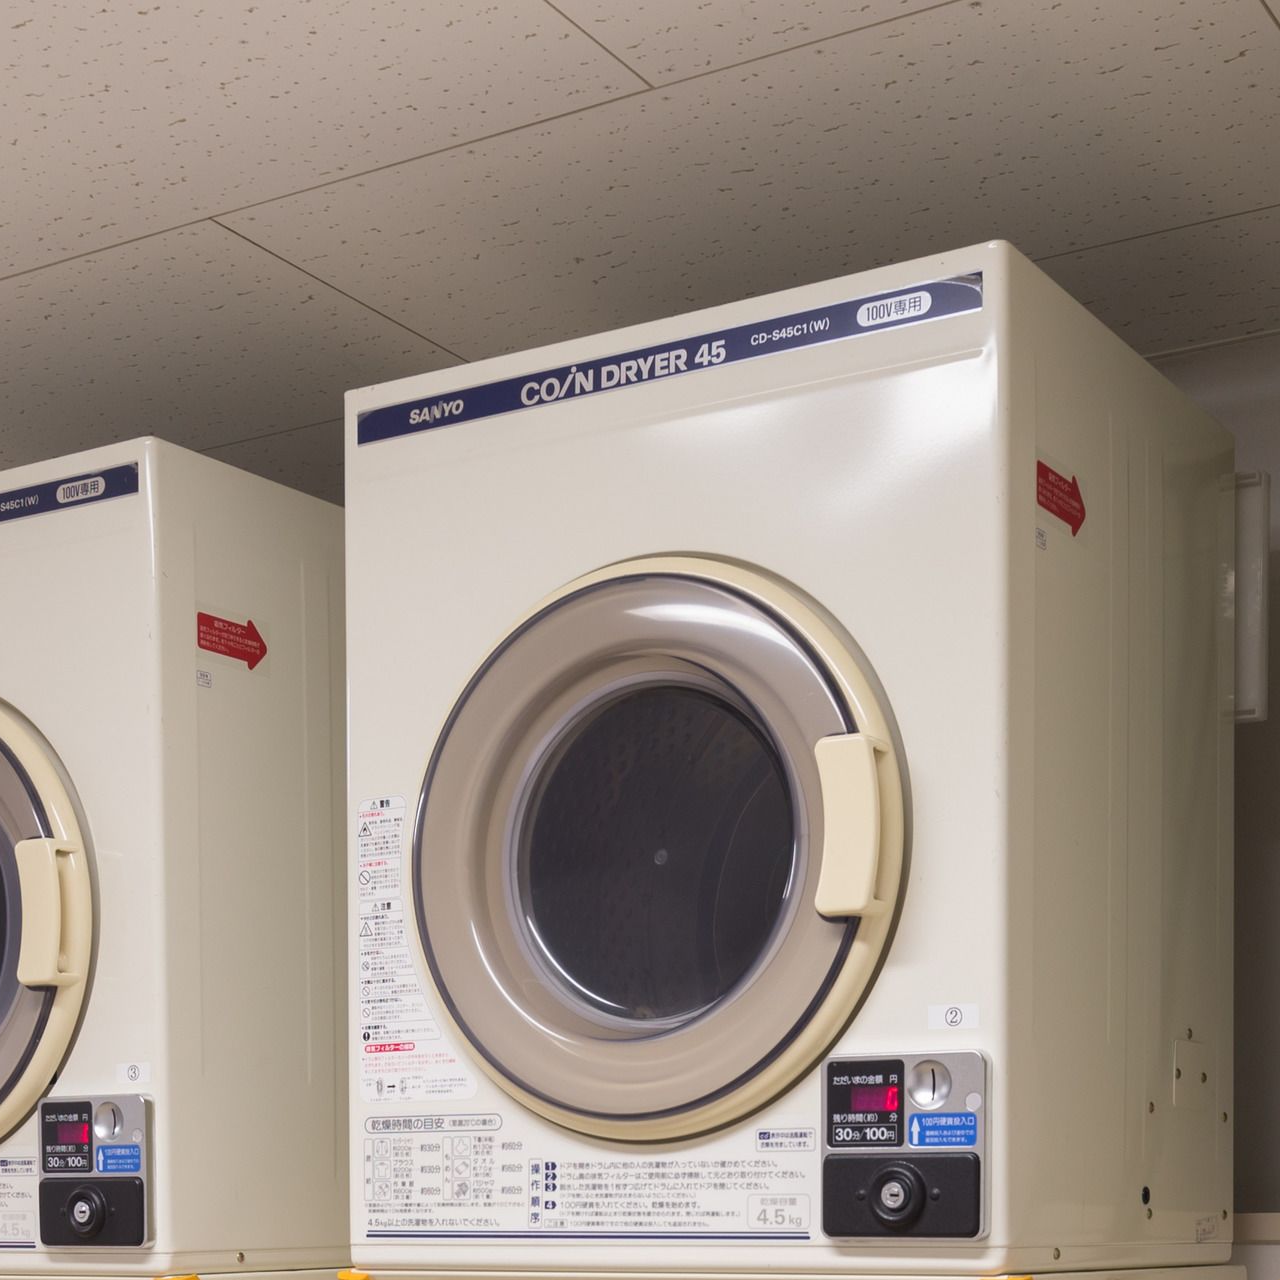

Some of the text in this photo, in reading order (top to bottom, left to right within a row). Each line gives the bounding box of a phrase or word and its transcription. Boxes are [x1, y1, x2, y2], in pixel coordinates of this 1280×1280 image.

[408, 400, 464, 425] SANYO
[600, 348, 688, 390] DRYER
[695, 340, 728, 367] 45
[750, 317, 831, 347] CD-S45C1(W)
[865, 294, 923, 323] 100V専用
[61, 480, 100, 500] 100V専用
[889, 1075, 898, 1084] 円
[889, 1113, 898, 1122] 分
[757, 1208, 803, 1227] 4.5 kg
[0, 1224, 19, 1237] 4.5
